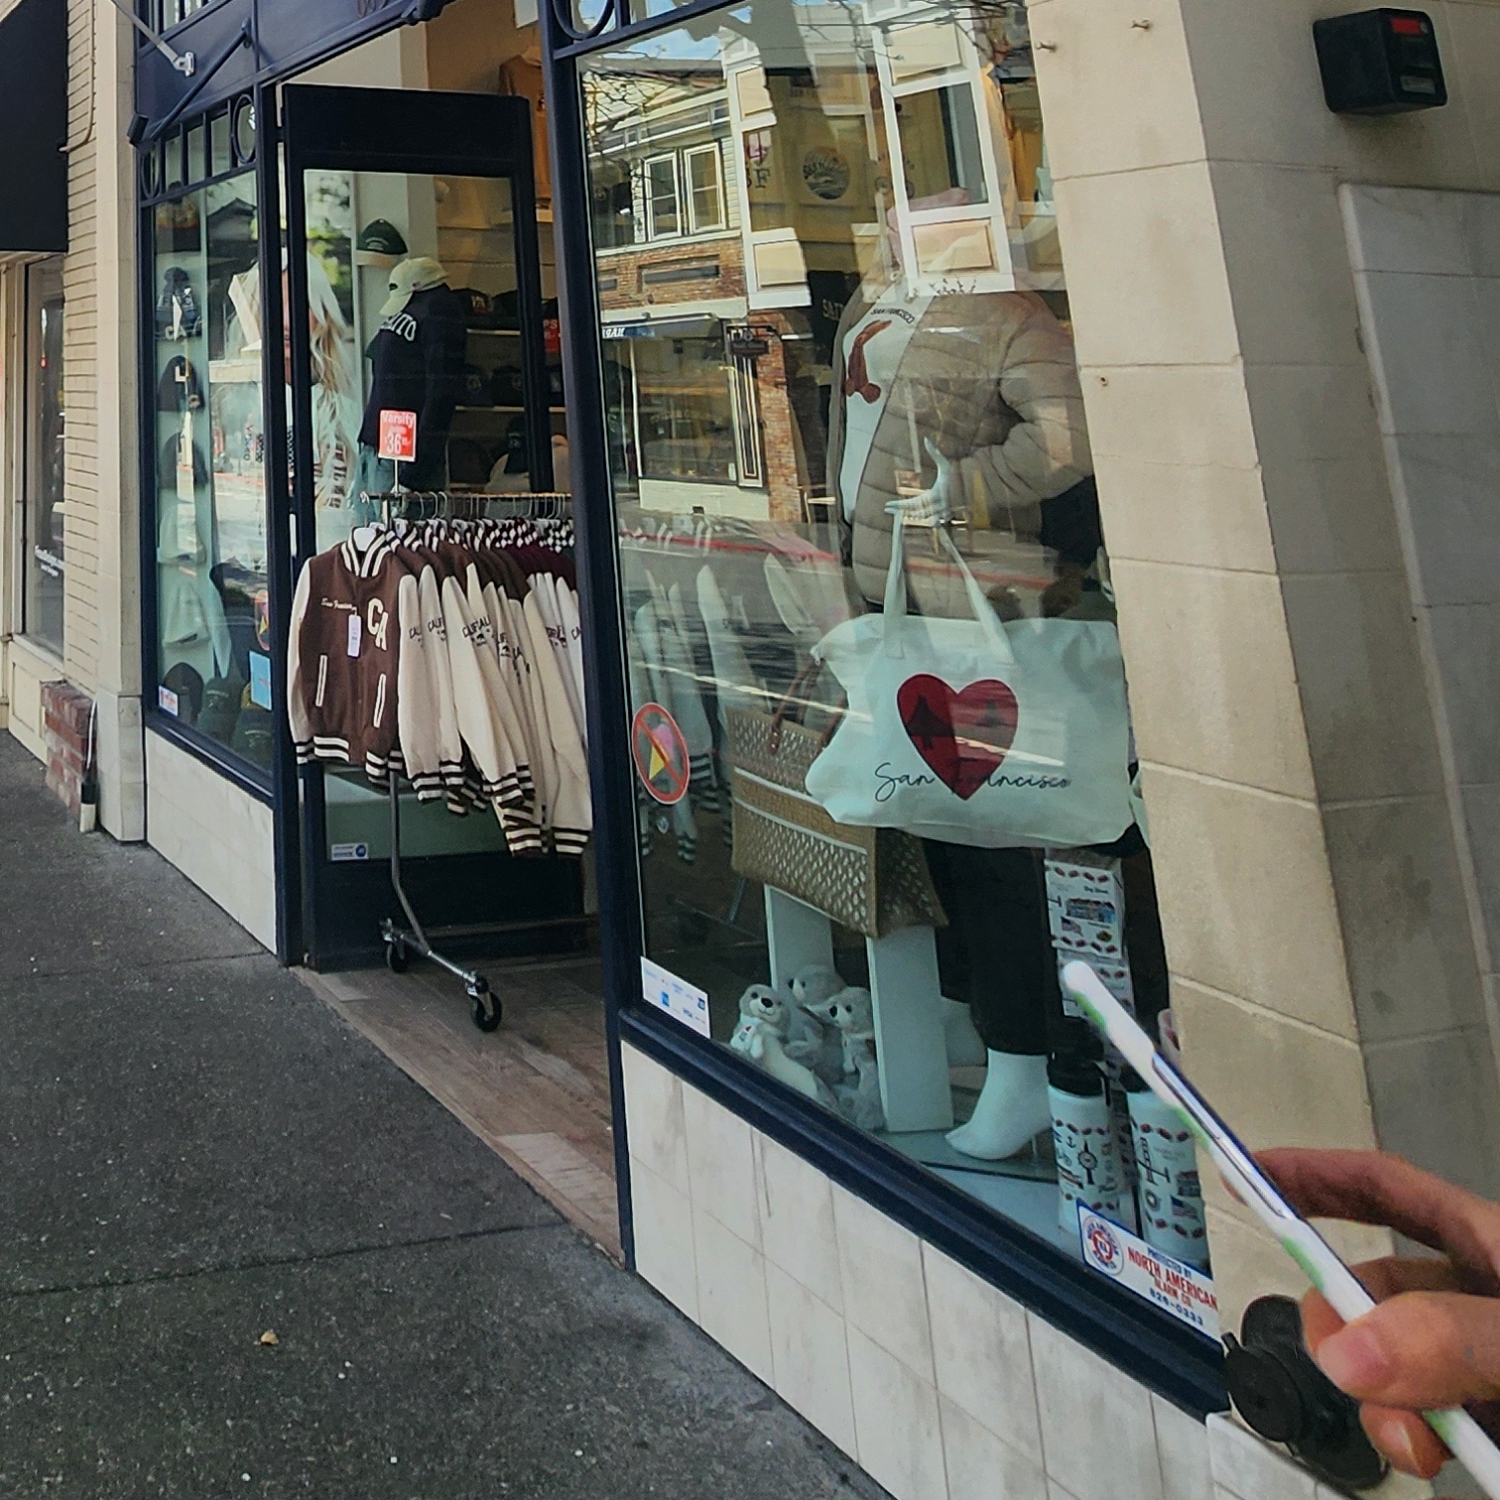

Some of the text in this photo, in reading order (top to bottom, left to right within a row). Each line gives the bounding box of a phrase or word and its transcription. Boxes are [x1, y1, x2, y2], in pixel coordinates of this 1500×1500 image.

[382, 411, 414, 428] Varsity
[367, 597, 389, 652] CA
[874, 762, 936, 803] San
[1127, 1246, 1219, 1312] NORTH AMERICAN
